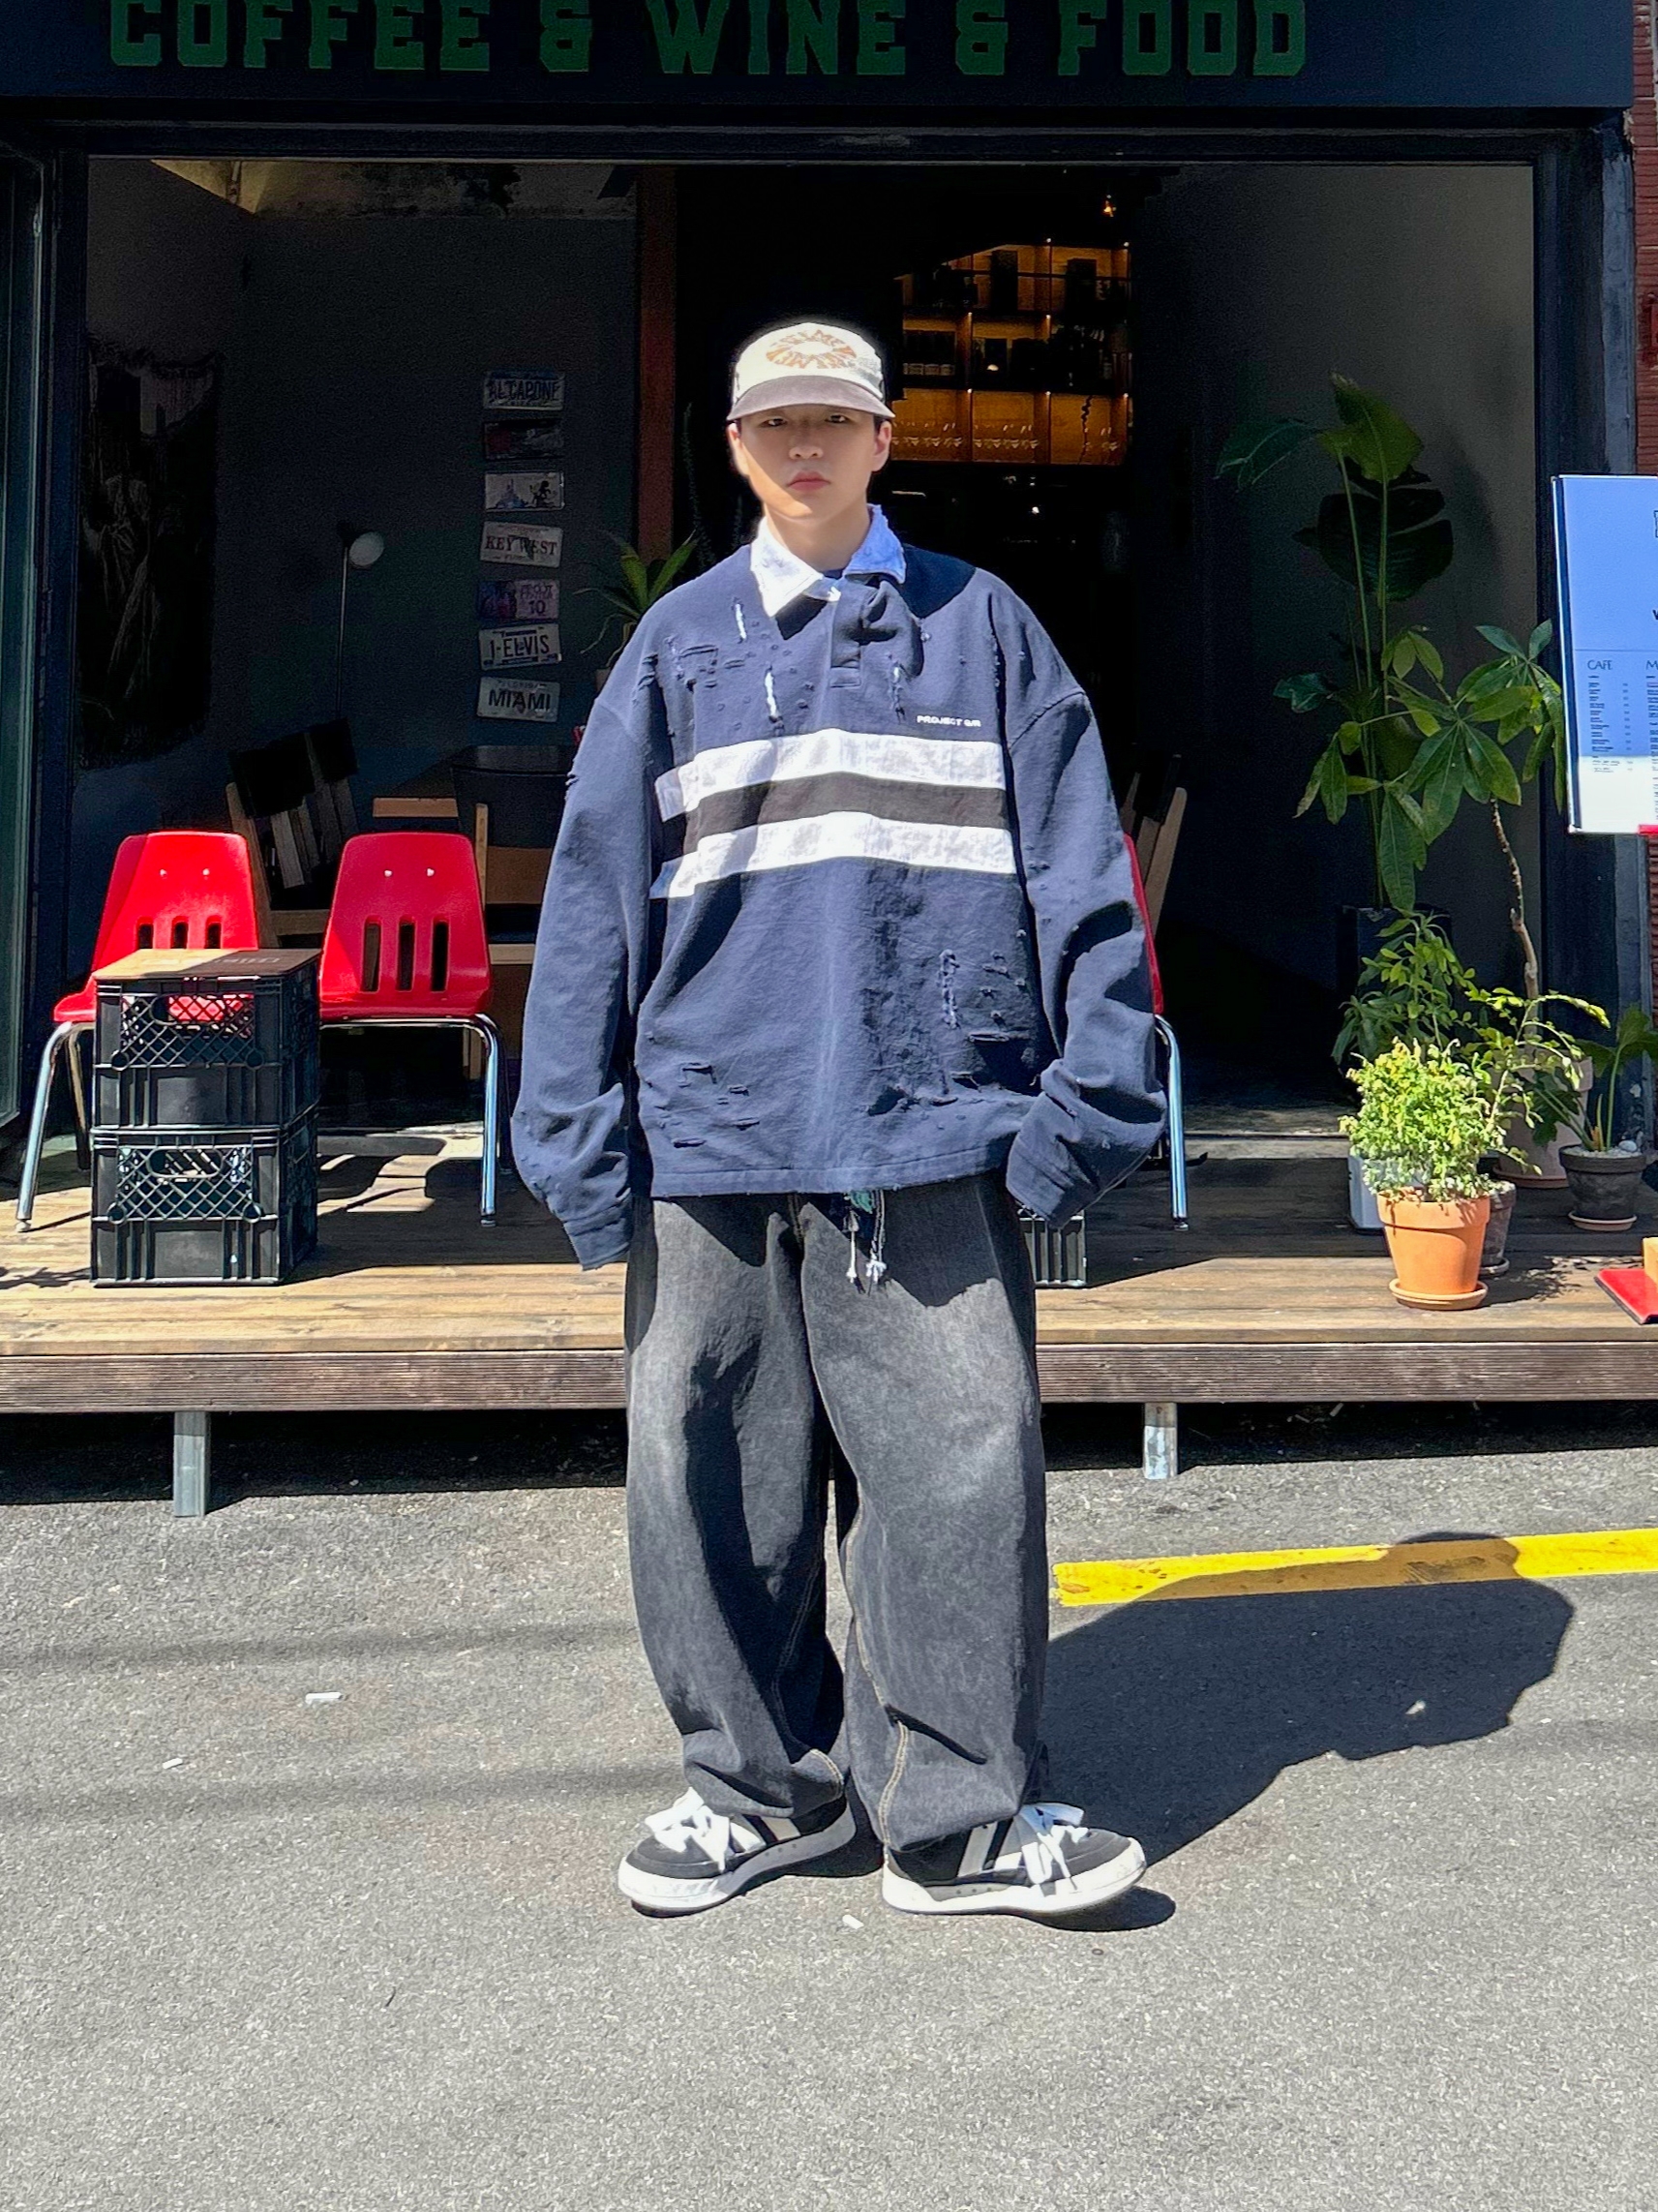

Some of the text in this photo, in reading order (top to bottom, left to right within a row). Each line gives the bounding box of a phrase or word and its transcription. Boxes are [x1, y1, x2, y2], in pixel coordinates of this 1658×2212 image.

[109, 0, 1307, 76] COFFEE & WINE & FOOD
[484, 534, 558, 555] KEY WEST
[1586, 658, 1613, 671] CAFE
[488, 688, 552, 710] MIAMI
[917, 715, 962, 726] PROJECT
